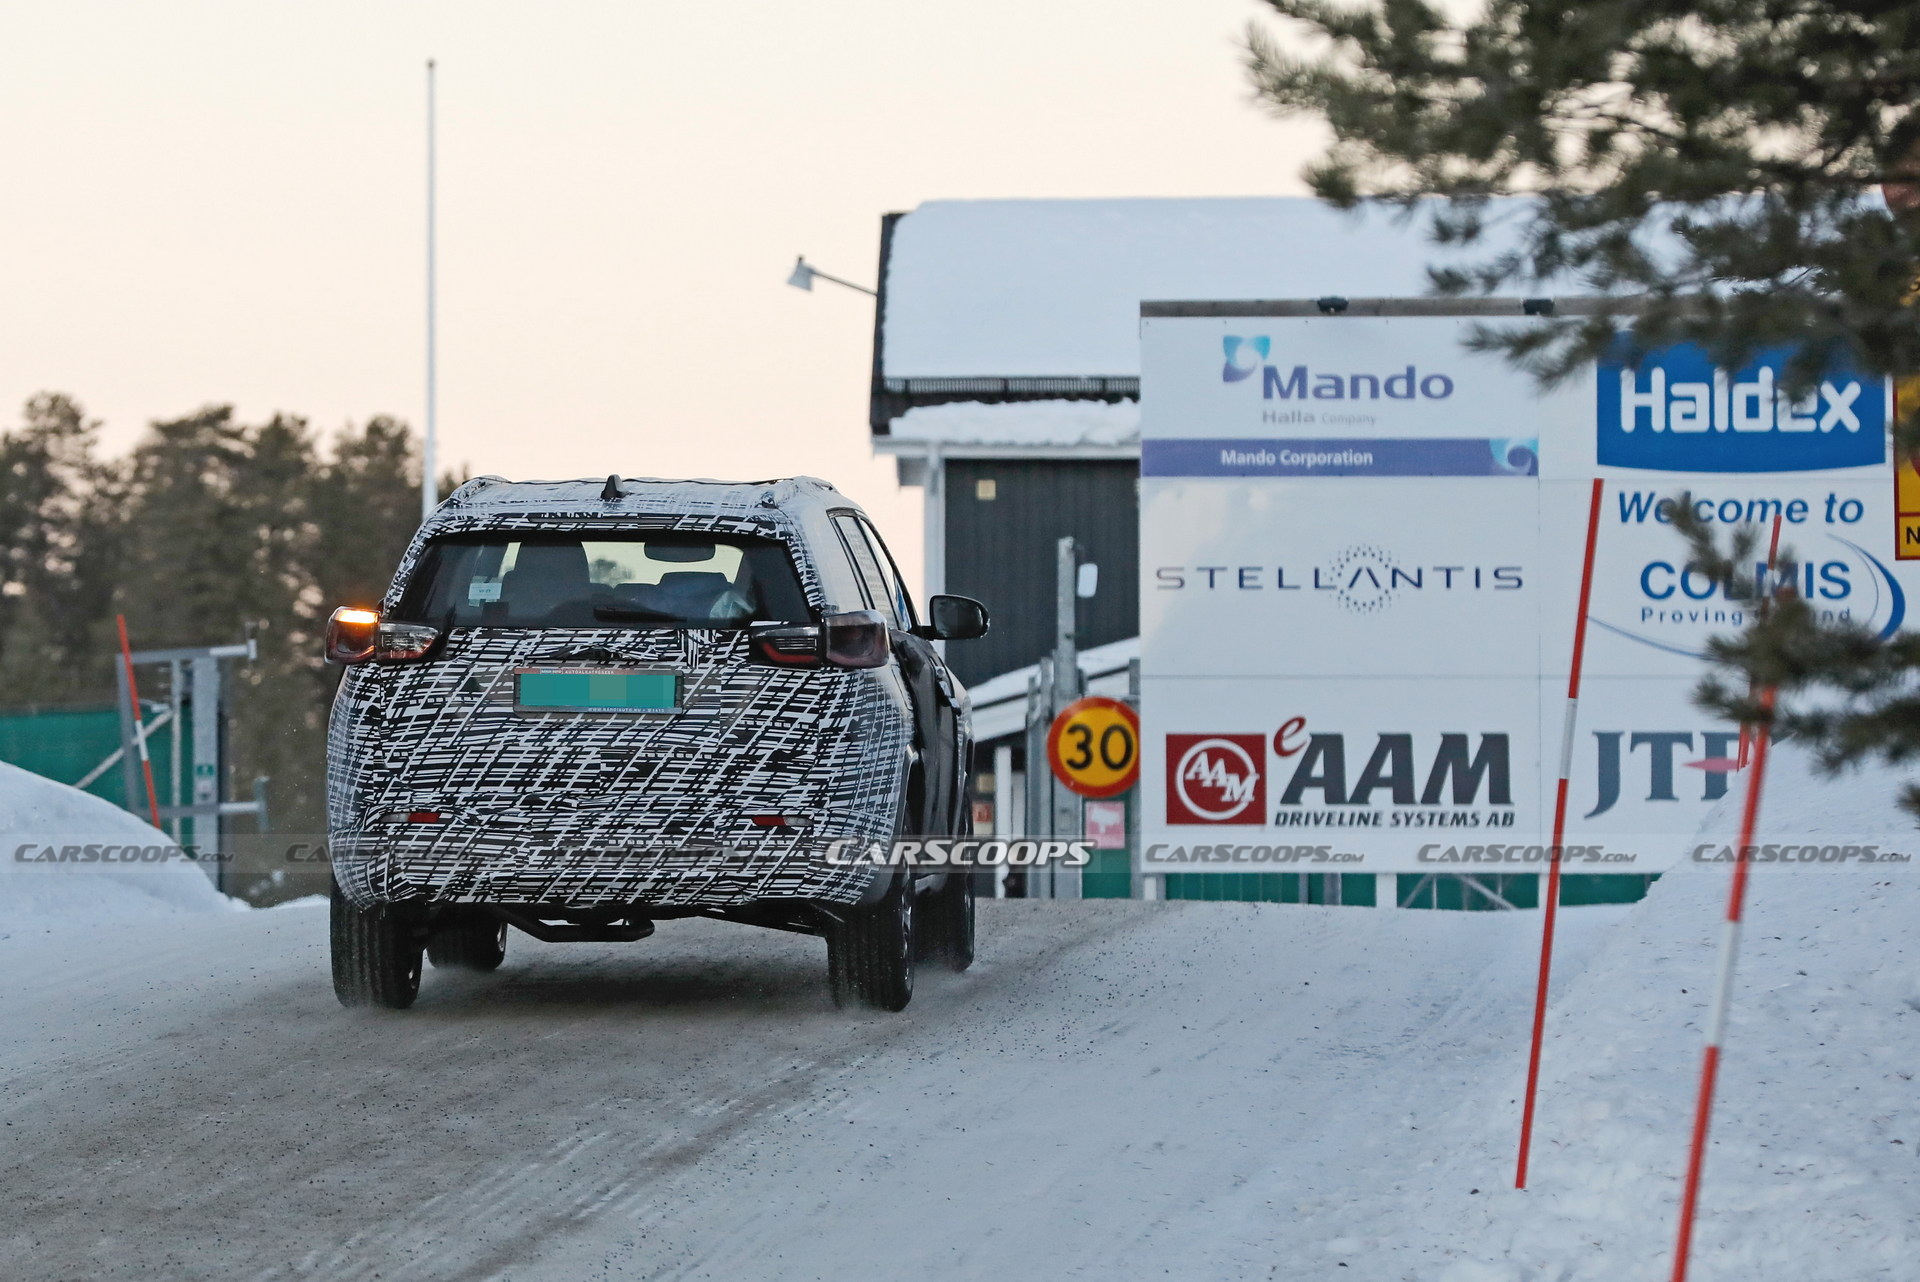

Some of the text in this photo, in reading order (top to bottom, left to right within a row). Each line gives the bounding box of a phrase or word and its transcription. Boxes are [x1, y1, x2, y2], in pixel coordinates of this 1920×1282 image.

[1263, 365, 1454, 400] Mando
[1620, 366, 1862, 433] Haldex
[1263, 410, 1377, 425] Halla Company
[1221, 450, 1374, 468] Mando Corporation
[1619, 491, 1864, 523] Wecome to
[1156, 566, 1523, 590] STELLANTIS
[1641, 607, 1744, 625] Proving
[1066, 723, 1133, 770] 30
[1186, 752, 1260, 803] AAM
[1275, 812, 1515, 827] DRIVELINE SYSTEMS AB
